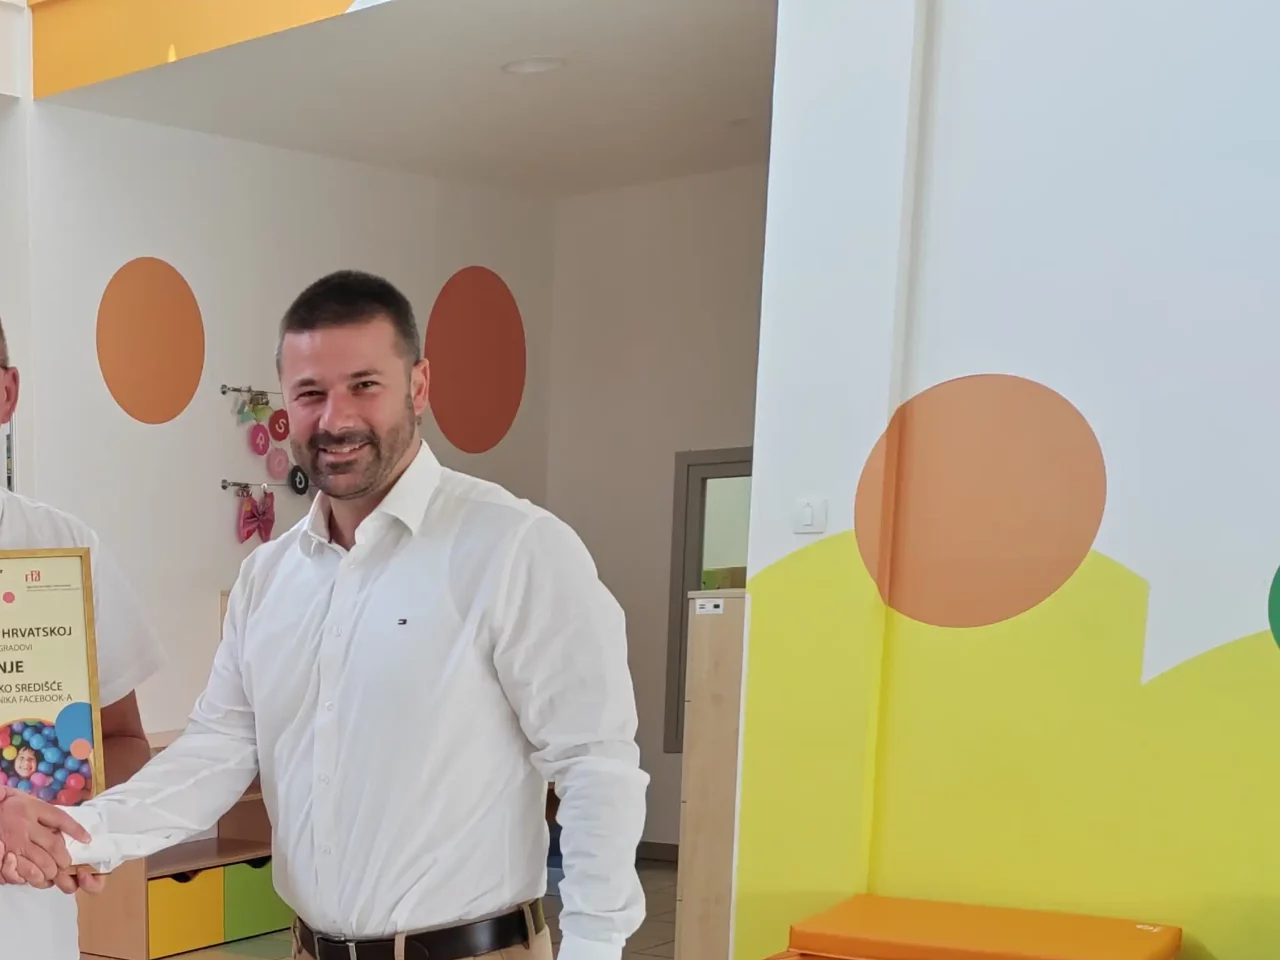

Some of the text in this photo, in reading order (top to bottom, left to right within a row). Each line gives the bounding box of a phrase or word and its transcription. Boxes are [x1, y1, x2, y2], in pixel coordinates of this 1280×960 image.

[1, 626, 72, 639] HRVATSKOJ
[15, 680, 63, 693] SREDIŠĆE
[19, 693, 73, 704] FACEBOOK-A
